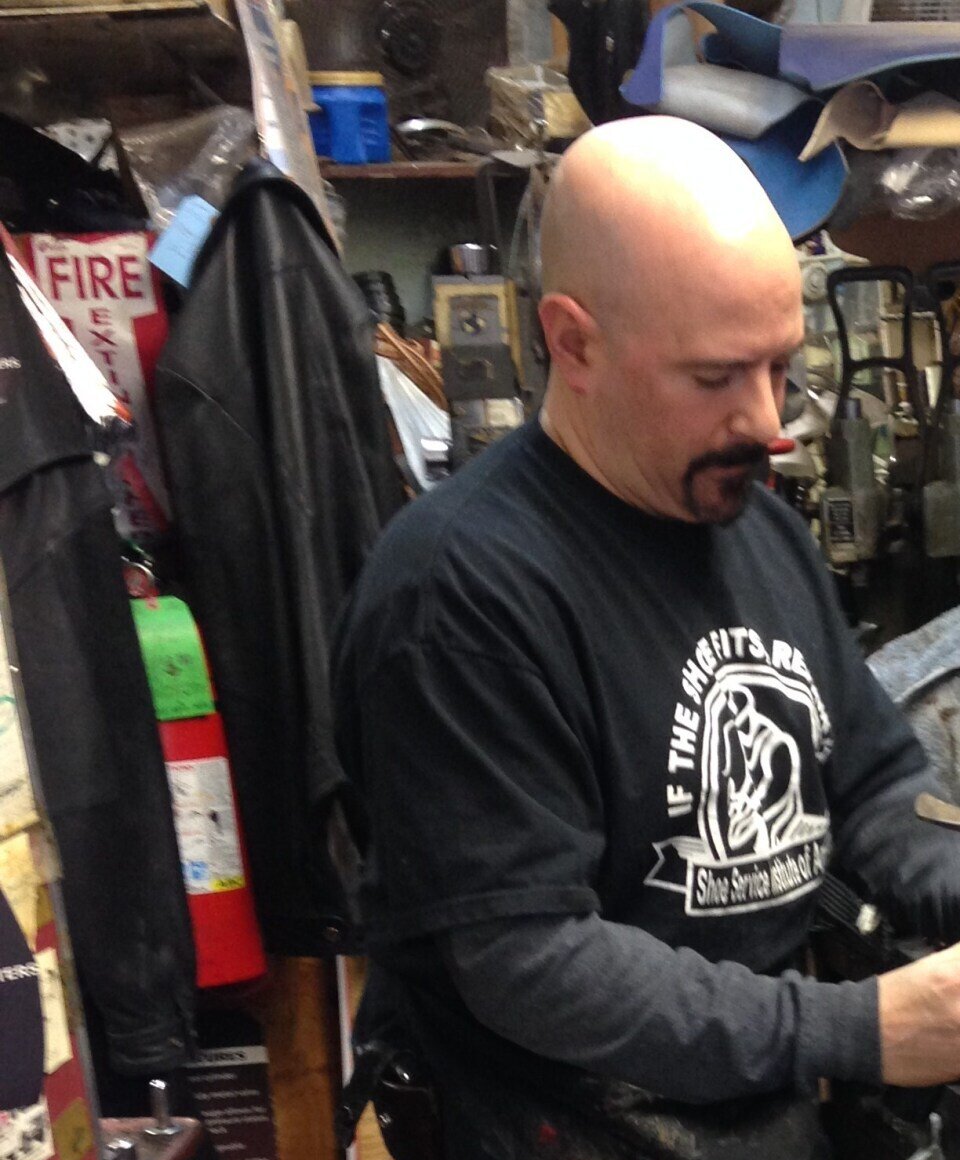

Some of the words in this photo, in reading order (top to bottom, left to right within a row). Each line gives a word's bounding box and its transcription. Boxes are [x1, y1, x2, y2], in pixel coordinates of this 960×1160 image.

[47, 255, 144, 300] FIRE
[668, 702, 700, 774] THE
[666, 783, 693, 818] IF
